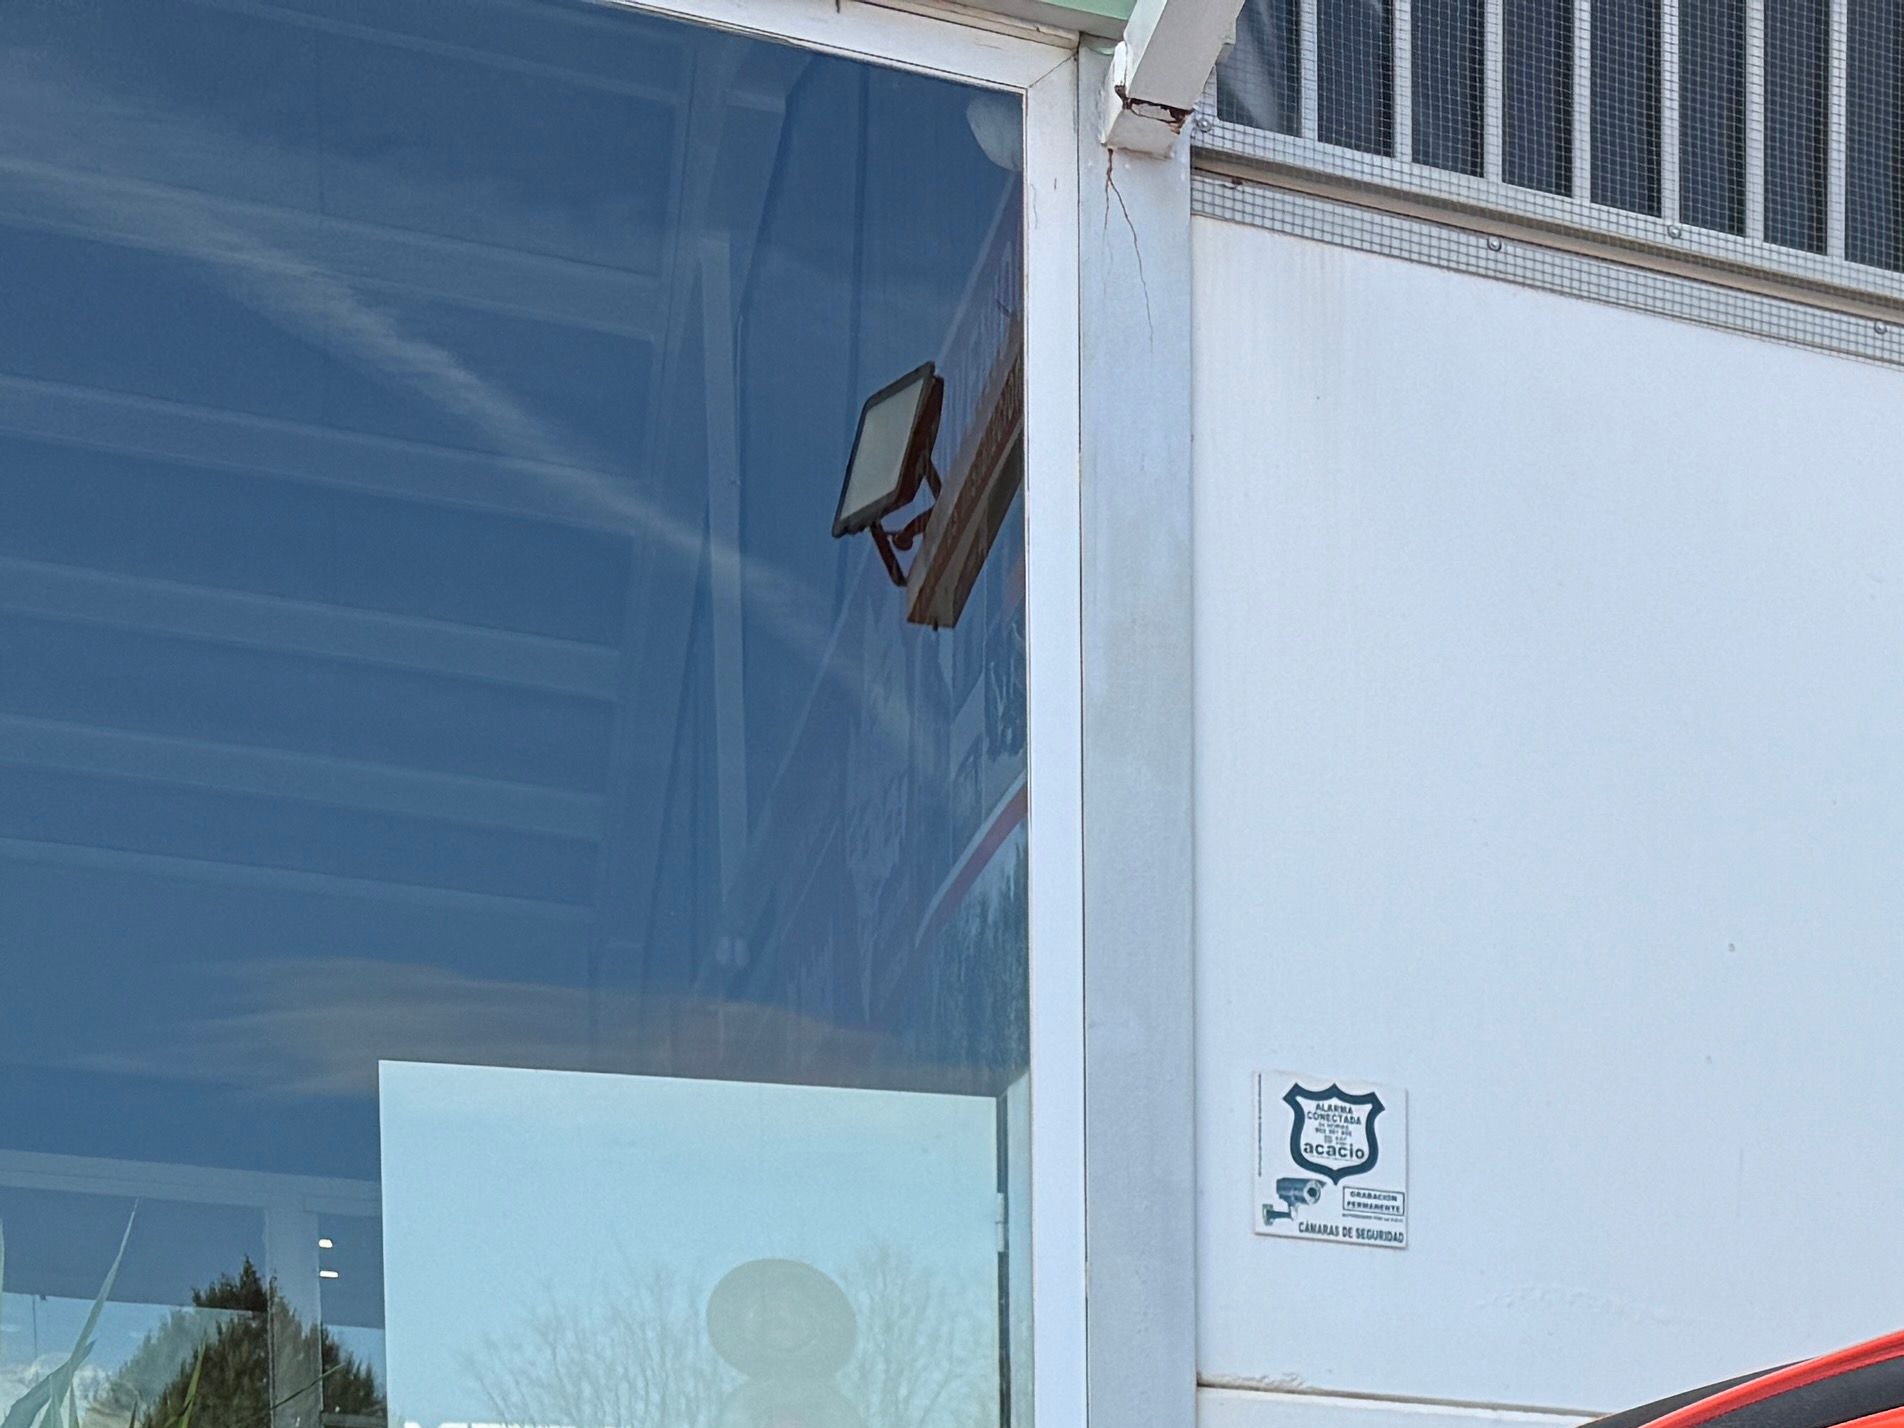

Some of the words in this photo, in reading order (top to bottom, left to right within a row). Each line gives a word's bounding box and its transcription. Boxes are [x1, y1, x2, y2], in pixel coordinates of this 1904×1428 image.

[1315, 1103, 1353, 1115] ALARMA
[1306, 1111, 1362, 1125] CONECTADA
[1298, 1220, 1340, 1237] CÁMARAS
[1342, 1226, 1353, 1239] DE
[1355, 1227, 1405, 1244] SEGURIDAD
